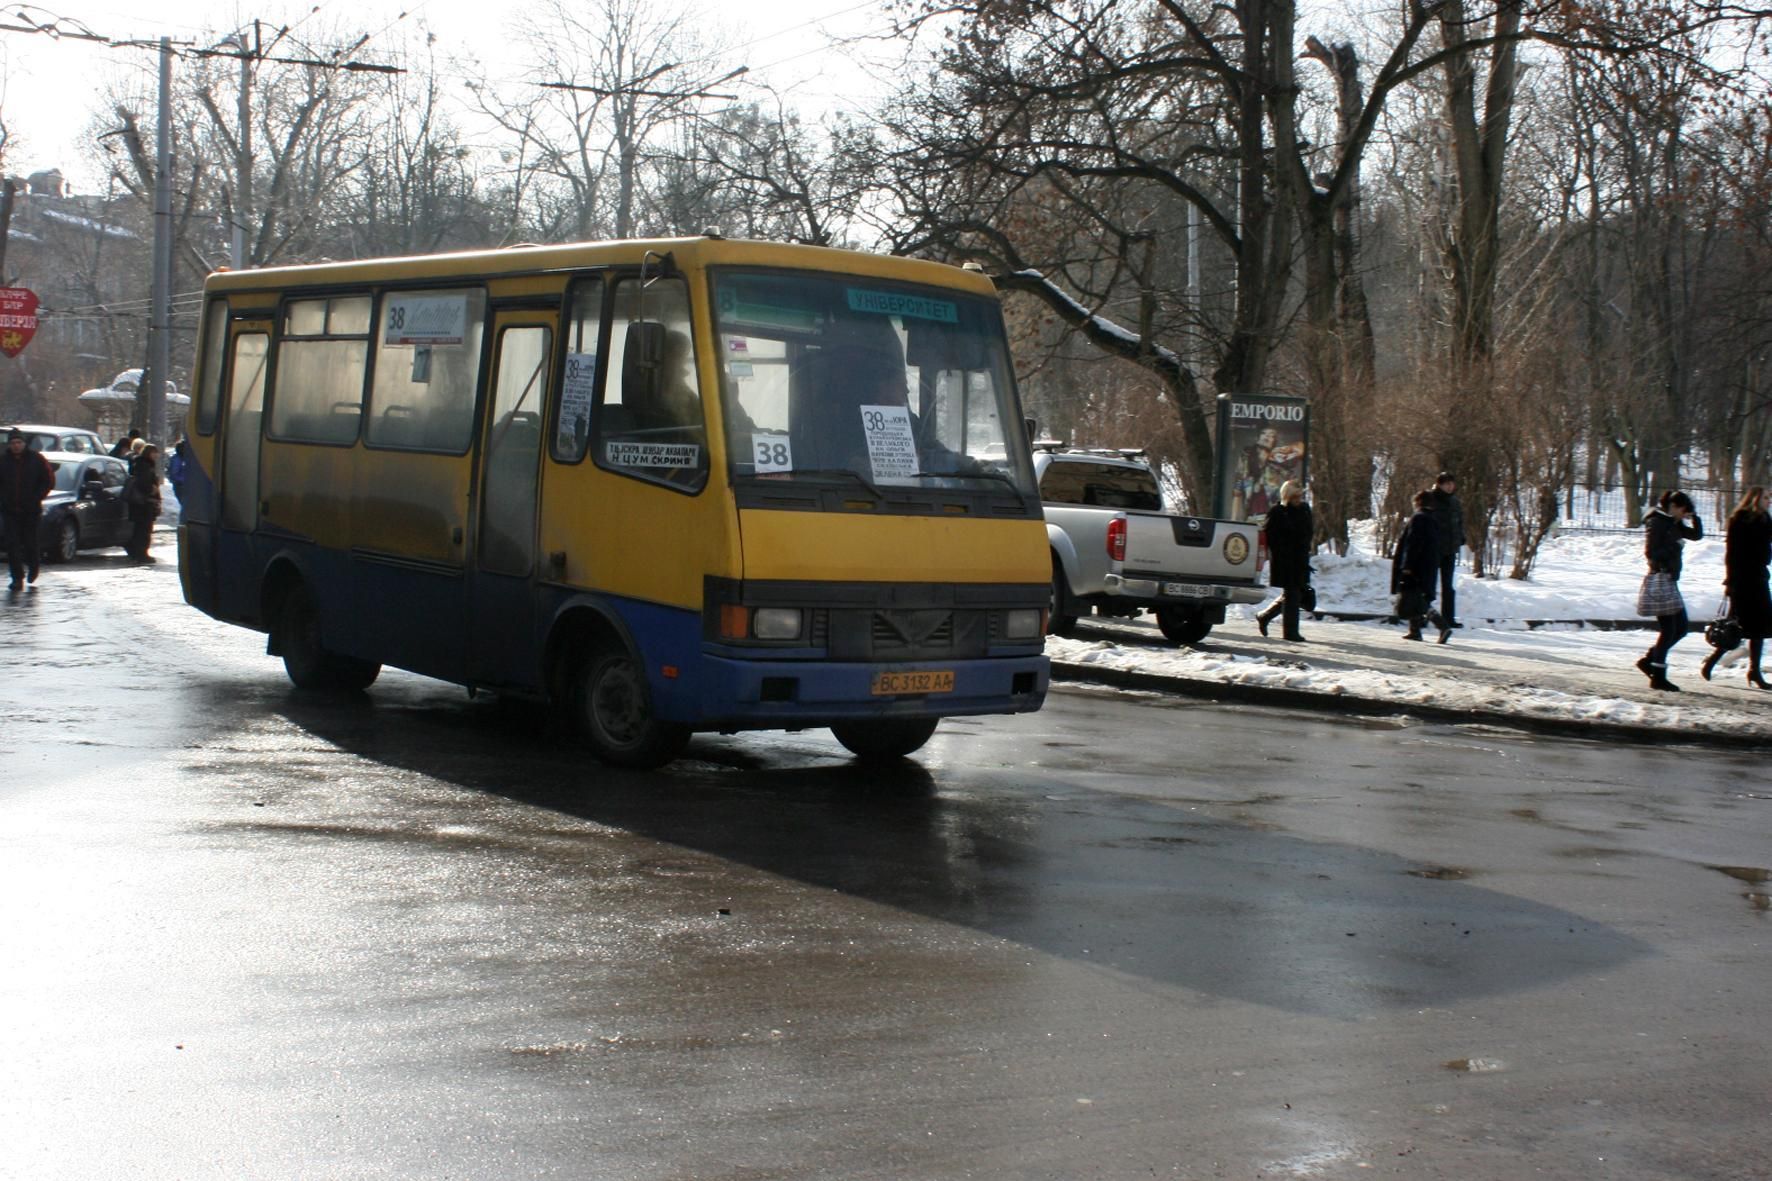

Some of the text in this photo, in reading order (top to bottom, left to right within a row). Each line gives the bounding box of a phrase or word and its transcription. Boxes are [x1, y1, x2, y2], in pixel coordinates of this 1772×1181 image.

[855, 292, 950, 318] УНІВЕРСИТЕТ
[389, 307, 405, 330] 38
[566, 359, 579, 379] 38
[864, 411, 885, 431] 38
[1231, 403, 1304, 421] EMPORIO
[757, 442, 789, 466] 38
[880, 676, 899, 692] BC
[901, 675, 931, 690] 3132
